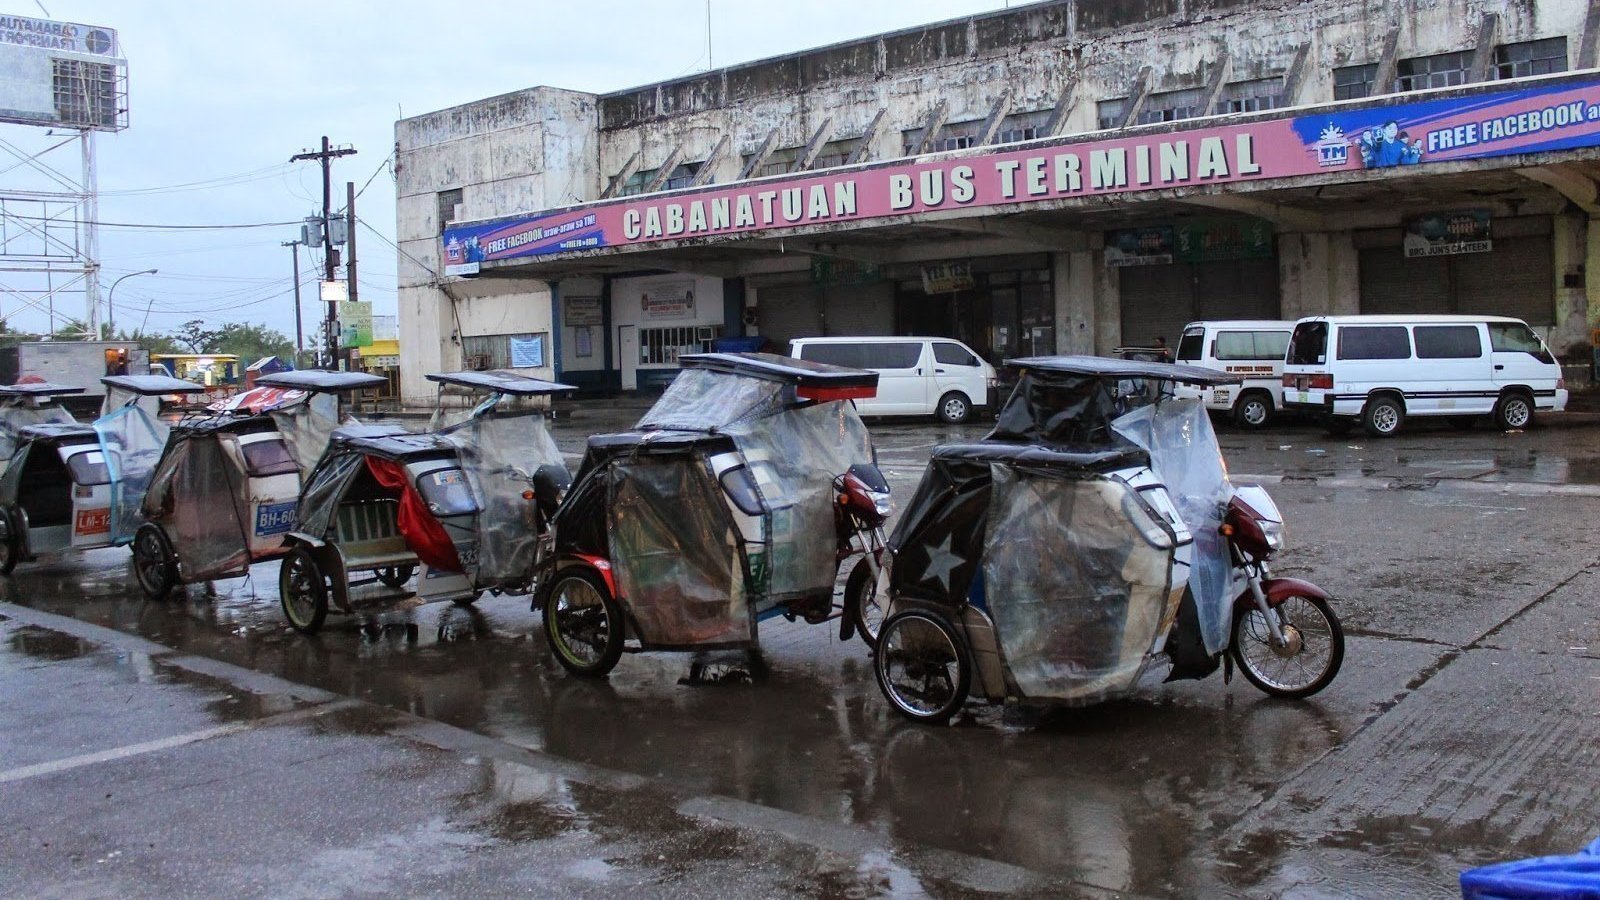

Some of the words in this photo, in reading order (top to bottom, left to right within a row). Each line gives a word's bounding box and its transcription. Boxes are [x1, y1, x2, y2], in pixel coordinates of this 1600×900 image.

[1428, 127, 1477, 151] FREE
[1482, 101, 1584, 141] FACEBOOK
[1321, 146, 1346, 159] TM
[623, 180, 857, 240] CABANATUAN
[889, 165, 976, 210] BUS
[995, 133, 1260, 198] TERMINAL
[488, 240, 508, 254] FREE
[507, 227, 543, 248] FACEBOOK
[543, 222, 575, 238] araw-araw
[575, 219, 584, 229] sa
[1452, 241, 1488, 254] CANTEEN
[259, 509, 297, 528] BH-60
